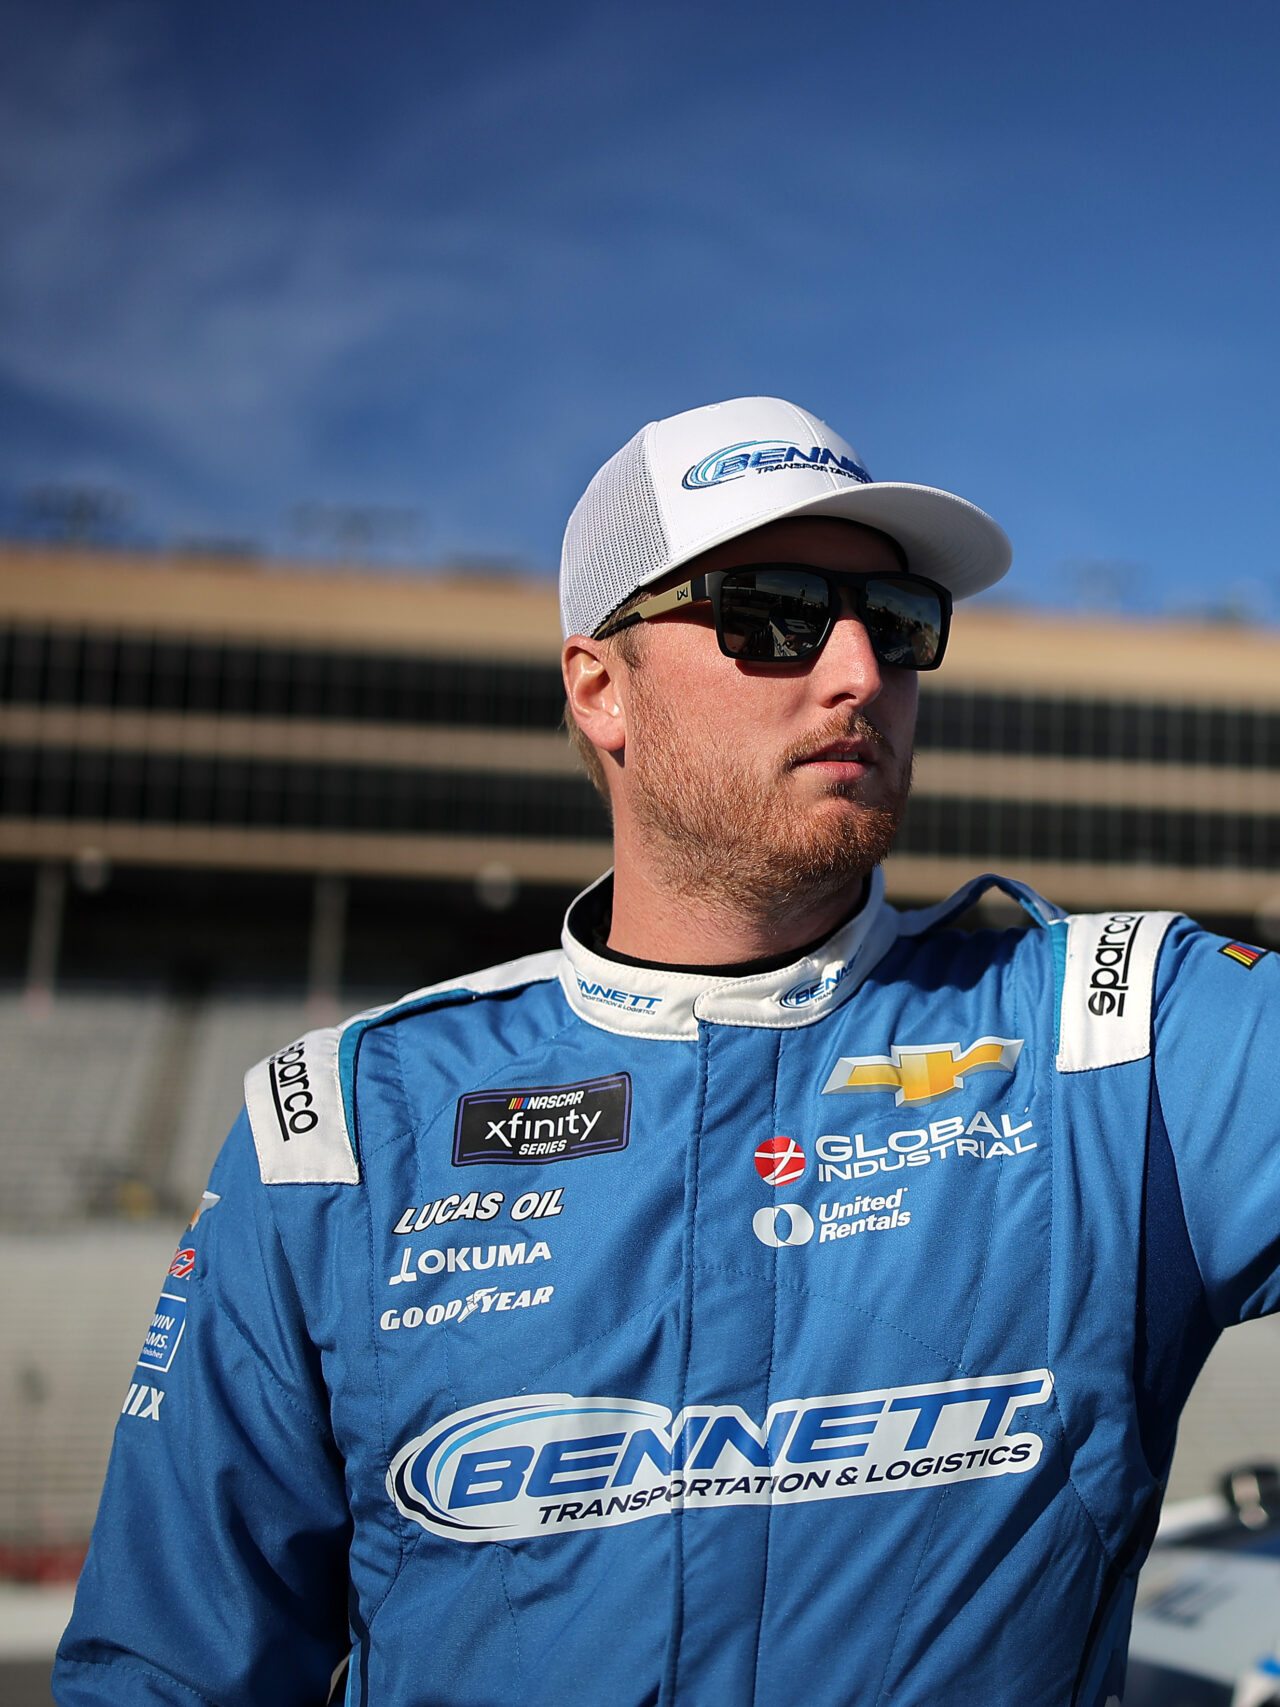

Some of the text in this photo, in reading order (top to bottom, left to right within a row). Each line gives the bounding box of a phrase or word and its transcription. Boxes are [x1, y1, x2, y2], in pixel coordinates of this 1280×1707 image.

[1088, 915, 1136, 1017] sparco
[527, 1091, 584, 1110] NASCAR
[485, 1109, 602, 1147] xfinity
[519, 1140, 567, 1156] SERIES
[816, 1111, 1034, 1162] GLOBAL
[818, 1136, 1038, 1183] INDUSTRIAL
[393, 1187, 565, 1234] LUCAS OIL
[819, 1210, 911, 1243] Rentals
[820, 1188, 904, 1222] United
[380, 1286, 554, 1331] GOODYEAR
[447, 1379, 1045, 1510] BENNETT
[538, 1443, 1033, 1525] TRANSPORTATION & LOGISTICS
